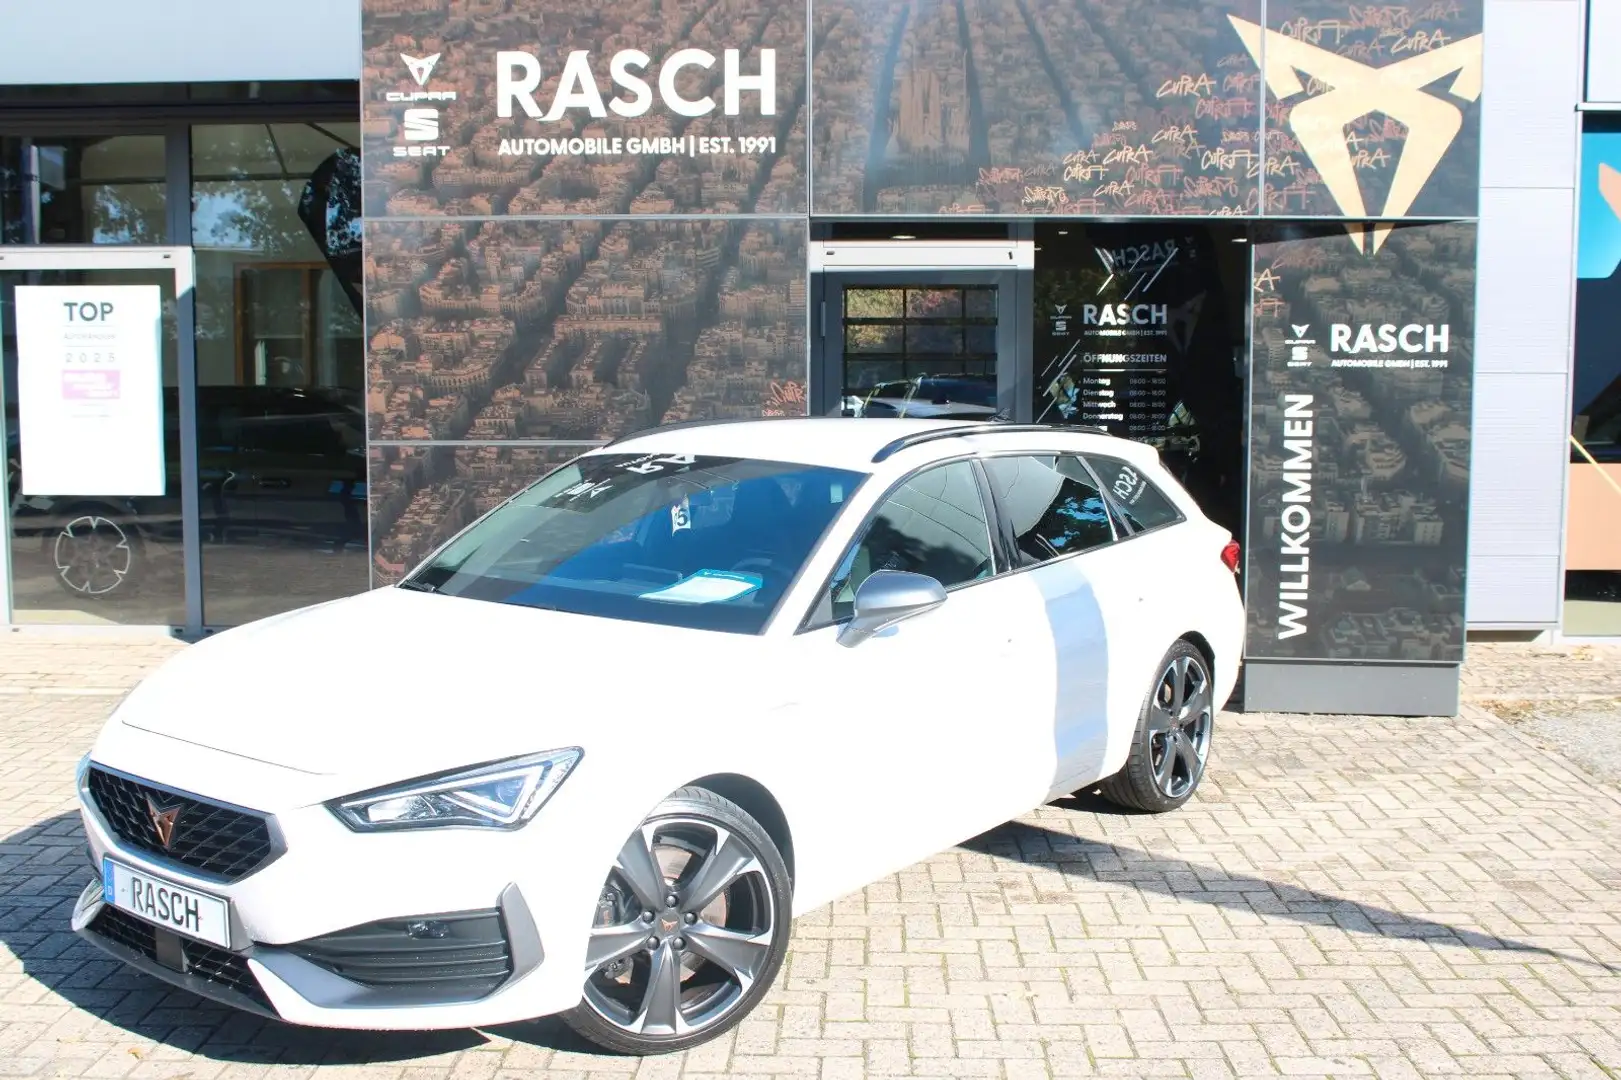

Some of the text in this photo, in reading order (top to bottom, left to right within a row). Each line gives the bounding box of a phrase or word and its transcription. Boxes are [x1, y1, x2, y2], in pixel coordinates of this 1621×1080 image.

[496, 48, 776, 121] RASCH
[1156, 73, 1216, 98] CUPRA
[393, 145, 450, 157] SEAT
[498, 136, 776, 155] AUTOMOBILE GMBH EST. 1991
[63, 302, 114, 321] TOP
[1083, 304, 1168, 326] RASCH
[1330, 323, 1449, 354] RASCH
[1331, 359, 1383, 368] AUTOMOBILE
[1083, 378, 1111, 386] Montag
[1083, 390, 1115, 398] Dienstag
[1278, 393, 1314, 640] WILLKOMMEN
[131, 876, 200, 933] RASCH
